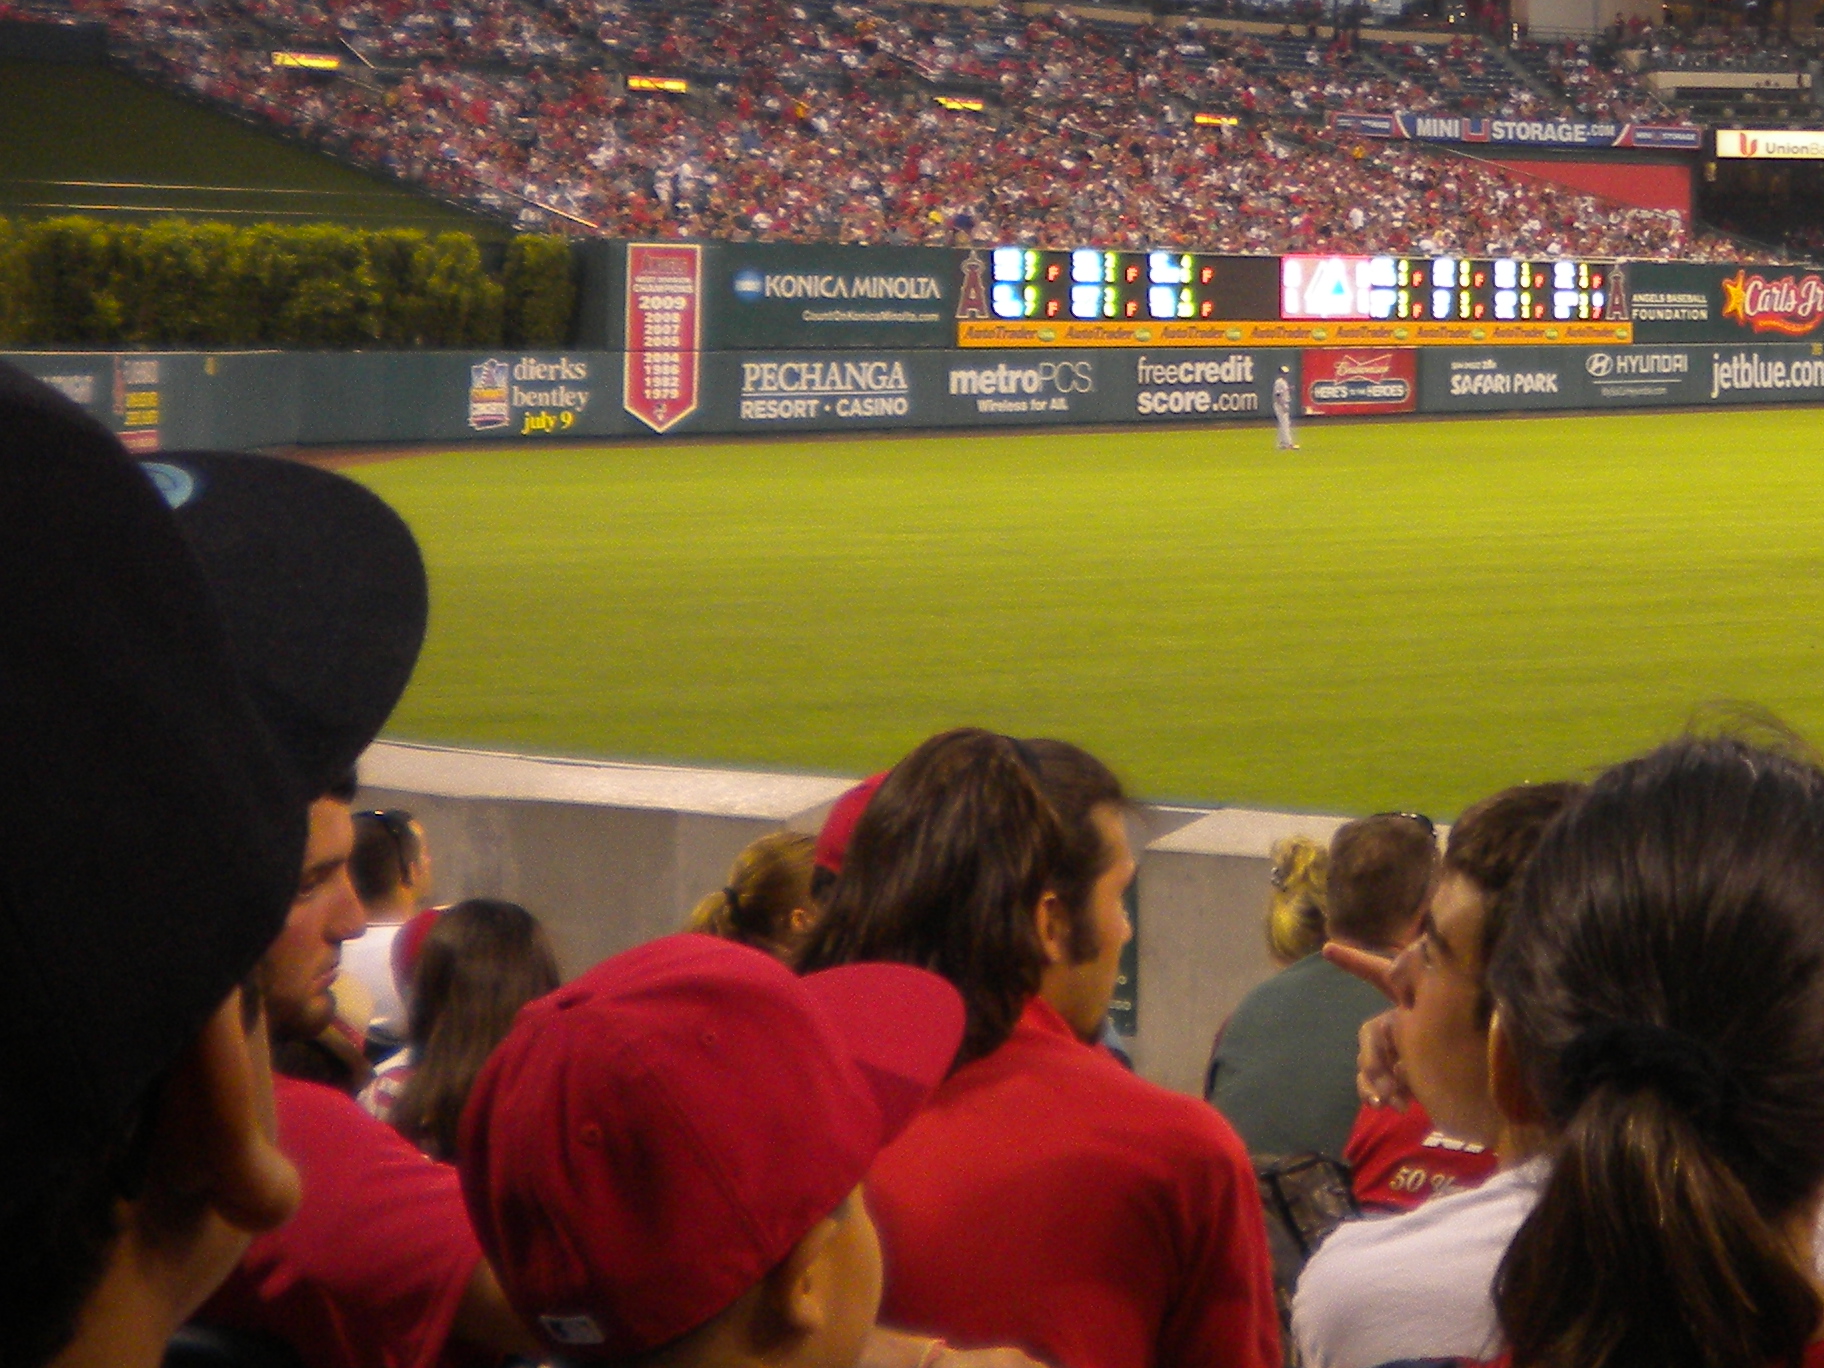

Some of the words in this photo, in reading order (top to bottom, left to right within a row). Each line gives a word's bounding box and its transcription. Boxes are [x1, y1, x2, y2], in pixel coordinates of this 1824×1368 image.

[1416, 117, 1461, 139] MINI
[1048, 265, 1059, 282] F
[1126, 265, 1138, 283] F
[1201, 267, 1213, 284] F
[765, 275, 850, 299] KONICA
[852, 276, 942, 299] MINOLTA
[638, 296, 687, 310] 2009
[1047, 300, 1059, 317] F
[1631, 293, 1664, 304] ANGELS
[1665, 293, 1707, 304] BASEBALL
[1126, 300, 1138, 318] F
[1201, 301, 1213, 318] F
[1631, 308, 1708, 321] FOUNDATION
[513, 357, 588, 381] dierks
[1137, 355, 1255, 385] freecredit
[1616, 354, 1688, 373] HYUNDAI
[741, 361, 909, 393] PECHANGA
[949, 361, 1096, 395] metroPCS
[1450, 373, 1511, 395] SAFARI
[1513, 373, 1558, 393] PARK
[512, 385, 590, 412] bentley
[740, 399, 820, 420] RESORT
[836, 397, 909, 418] CASINO
[976, 398, 1028, 413] Wireless
[1030, 398, 1047, 412] for
[1137, 389, 1259, 416] score.com
[521, 411, 557, 436] july
[560, 411, 575, 429] 9
